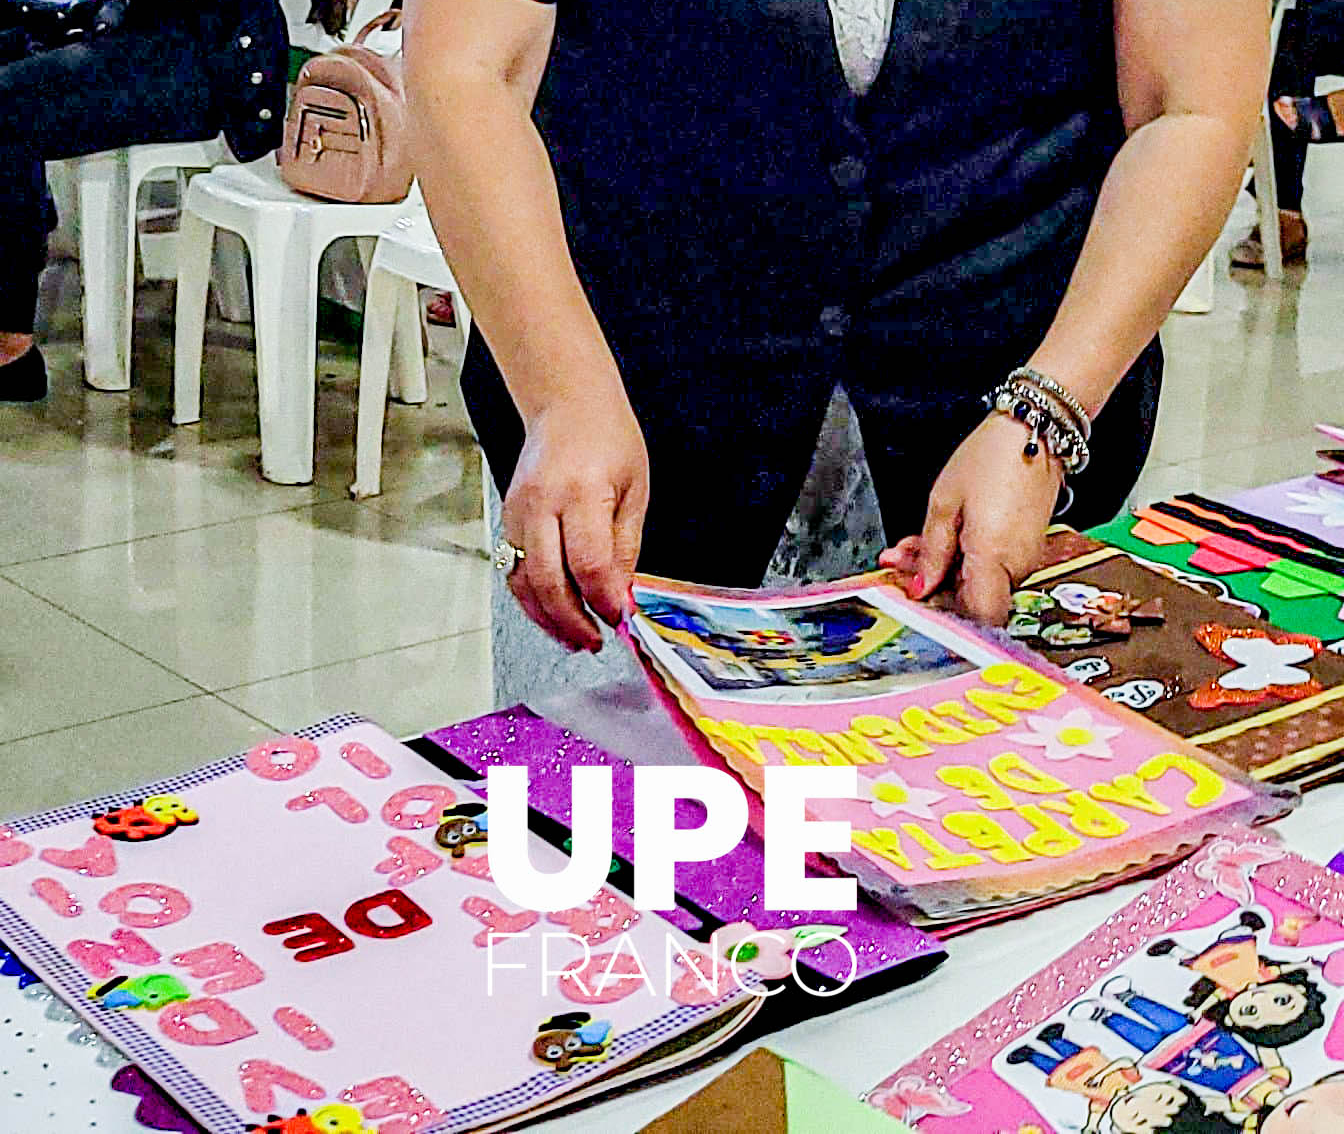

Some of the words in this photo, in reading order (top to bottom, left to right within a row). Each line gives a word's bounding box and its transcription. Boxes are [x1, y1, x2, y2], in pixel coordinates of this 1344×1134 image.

[853, 753, 1228, 872] CARPETA
[935, 752, 1070, 811] DE
[261, 889, 433, 963] DE
